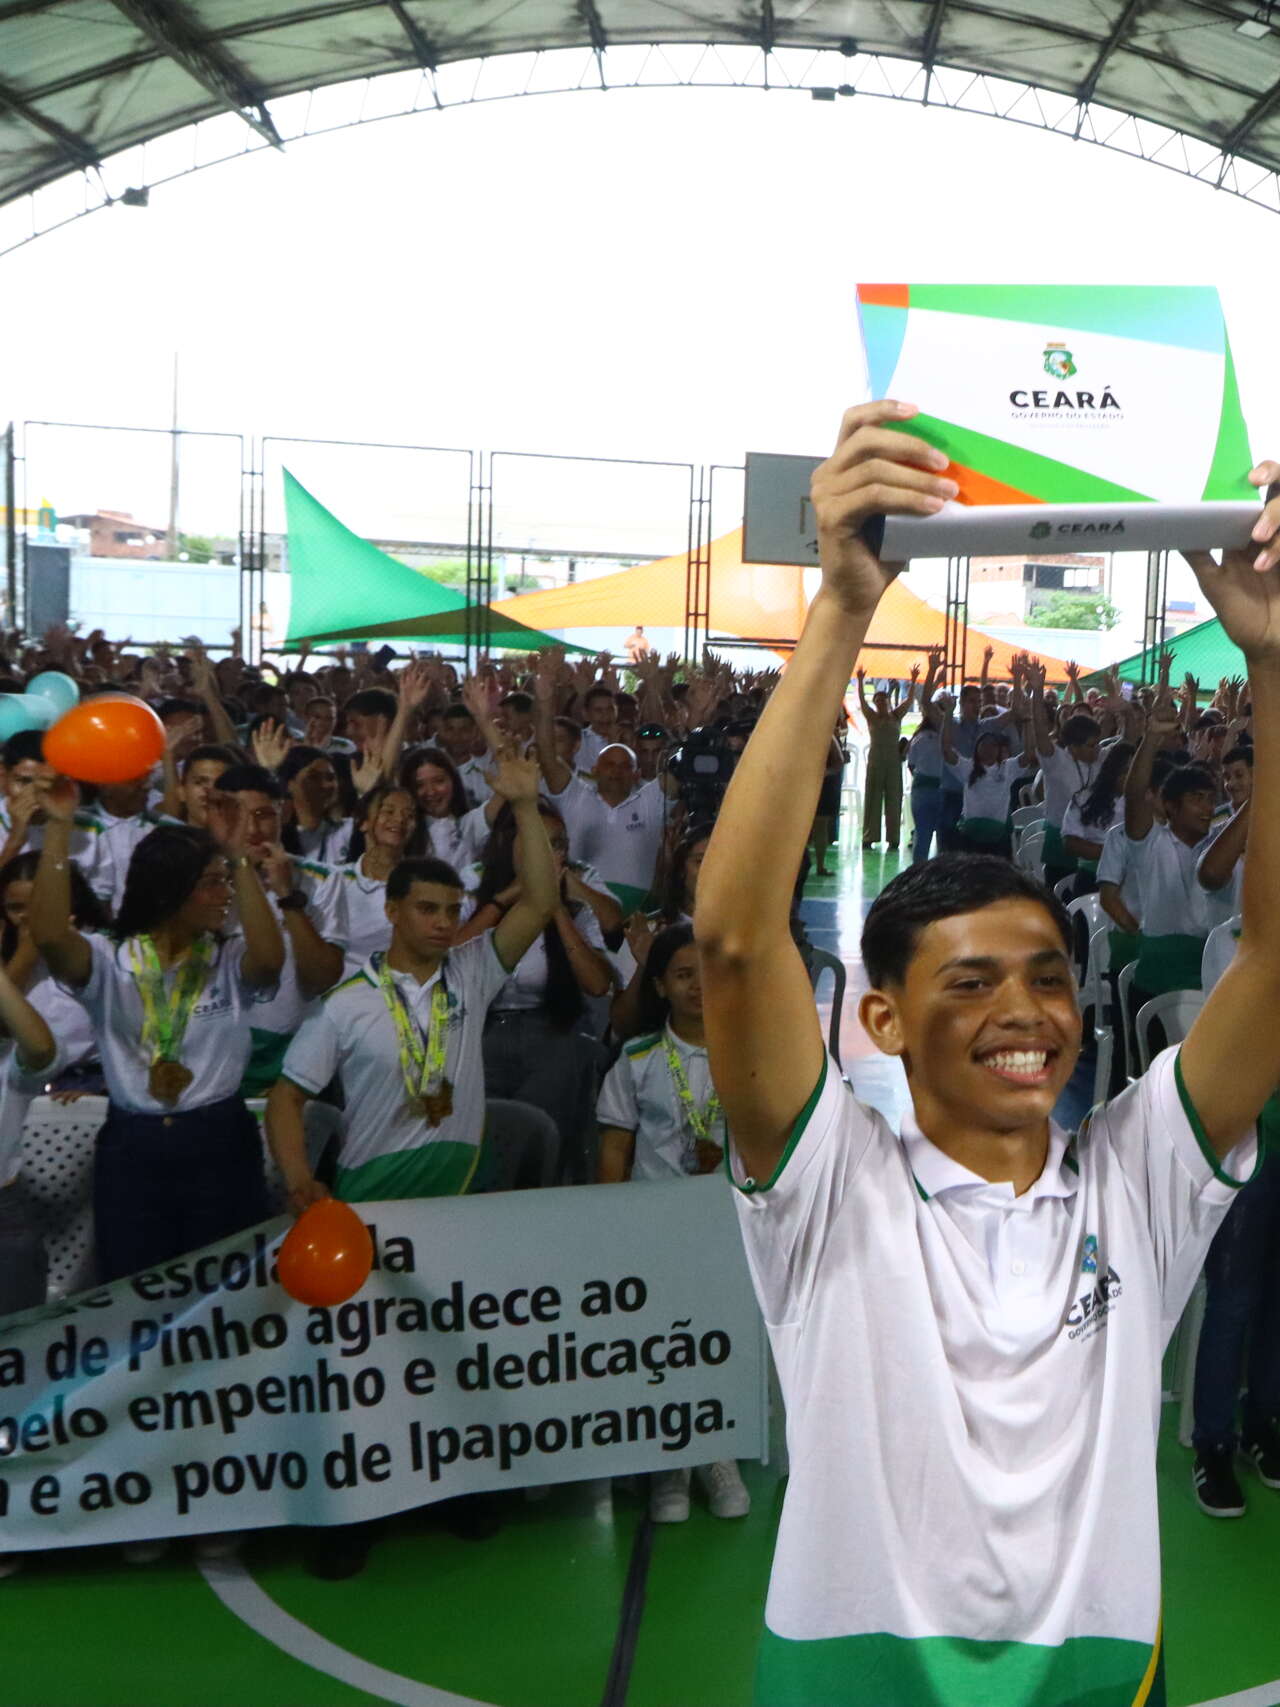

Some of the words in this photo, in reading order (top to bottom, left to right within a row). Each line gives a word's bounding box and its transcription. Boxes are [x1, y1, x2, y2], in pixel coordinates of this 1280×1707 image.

[1009, 385, 1121, 409] CEARÁ
[46, 1324, 109, 1381] de
[129, 1307, 288, 1372] Pinho
[306, 1281, 561, 1357] agradece
[580, 1275, 647, 1317] ao
[128, 1358, 385, 1434] empenho
[404, 1357, 436, 1395] e
[456, 1318, 732, 1392] dedicação
[30, 1474, 60, 1515] e
[79, 1471, 152, 1511] ao
[173, 1450, 308, 1515] povo
[323, 1432, 392, 1490] de
[410, 1397, 735, 1483] Ipaporanga.
